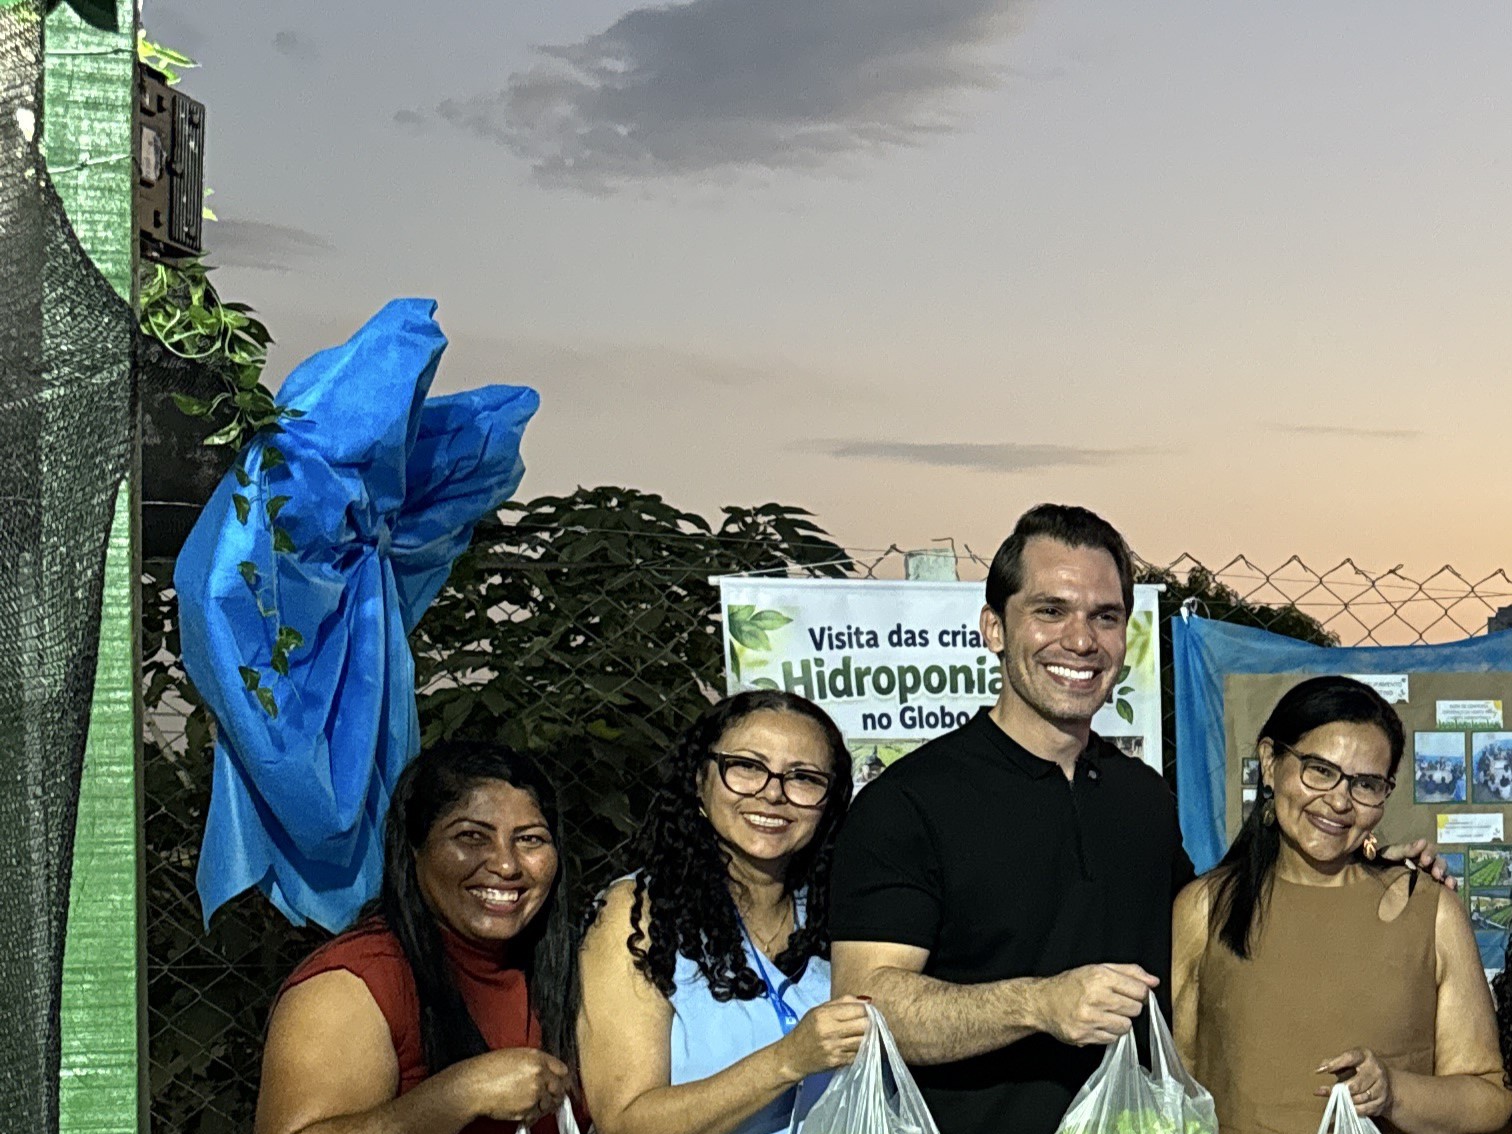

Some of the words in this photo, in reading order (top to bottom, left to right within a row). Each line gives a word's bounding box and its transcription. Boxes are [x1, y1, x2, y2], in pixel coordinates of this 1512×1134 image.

[808, 625, 879, 650] Visita
[888, 623, 929, 648] das
[782, 656, 1003, 704] Hidroponia
[862, 712, 892, 730] no
[900, 705, 971, 729] Globo
